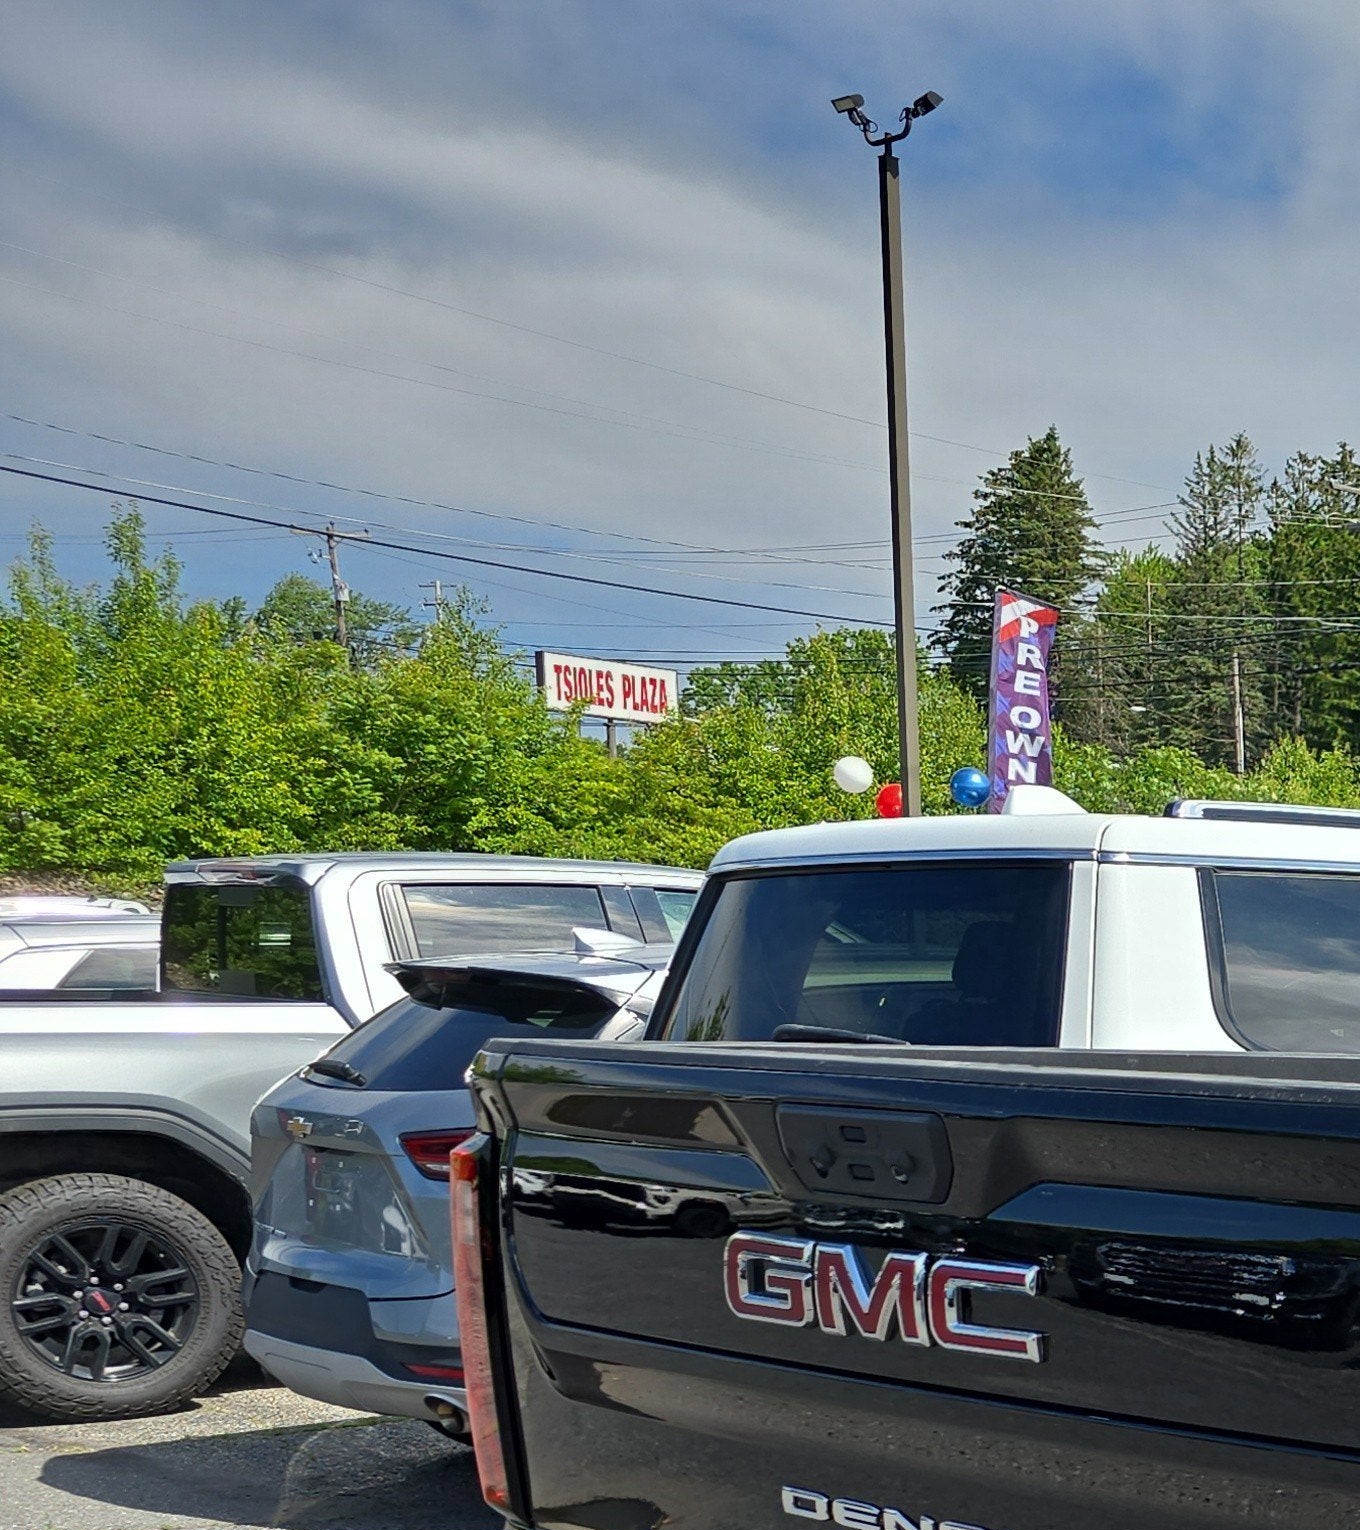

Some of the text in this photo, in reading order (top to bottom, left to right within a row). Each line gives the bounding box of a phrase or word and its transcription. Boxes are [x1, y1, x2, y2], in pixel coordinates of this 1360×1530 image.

[622, 674, 669, 715] PLAZA
[1013, 615, 1046, 697] PRE
[723, 1230, 1043, 1363] GMC
